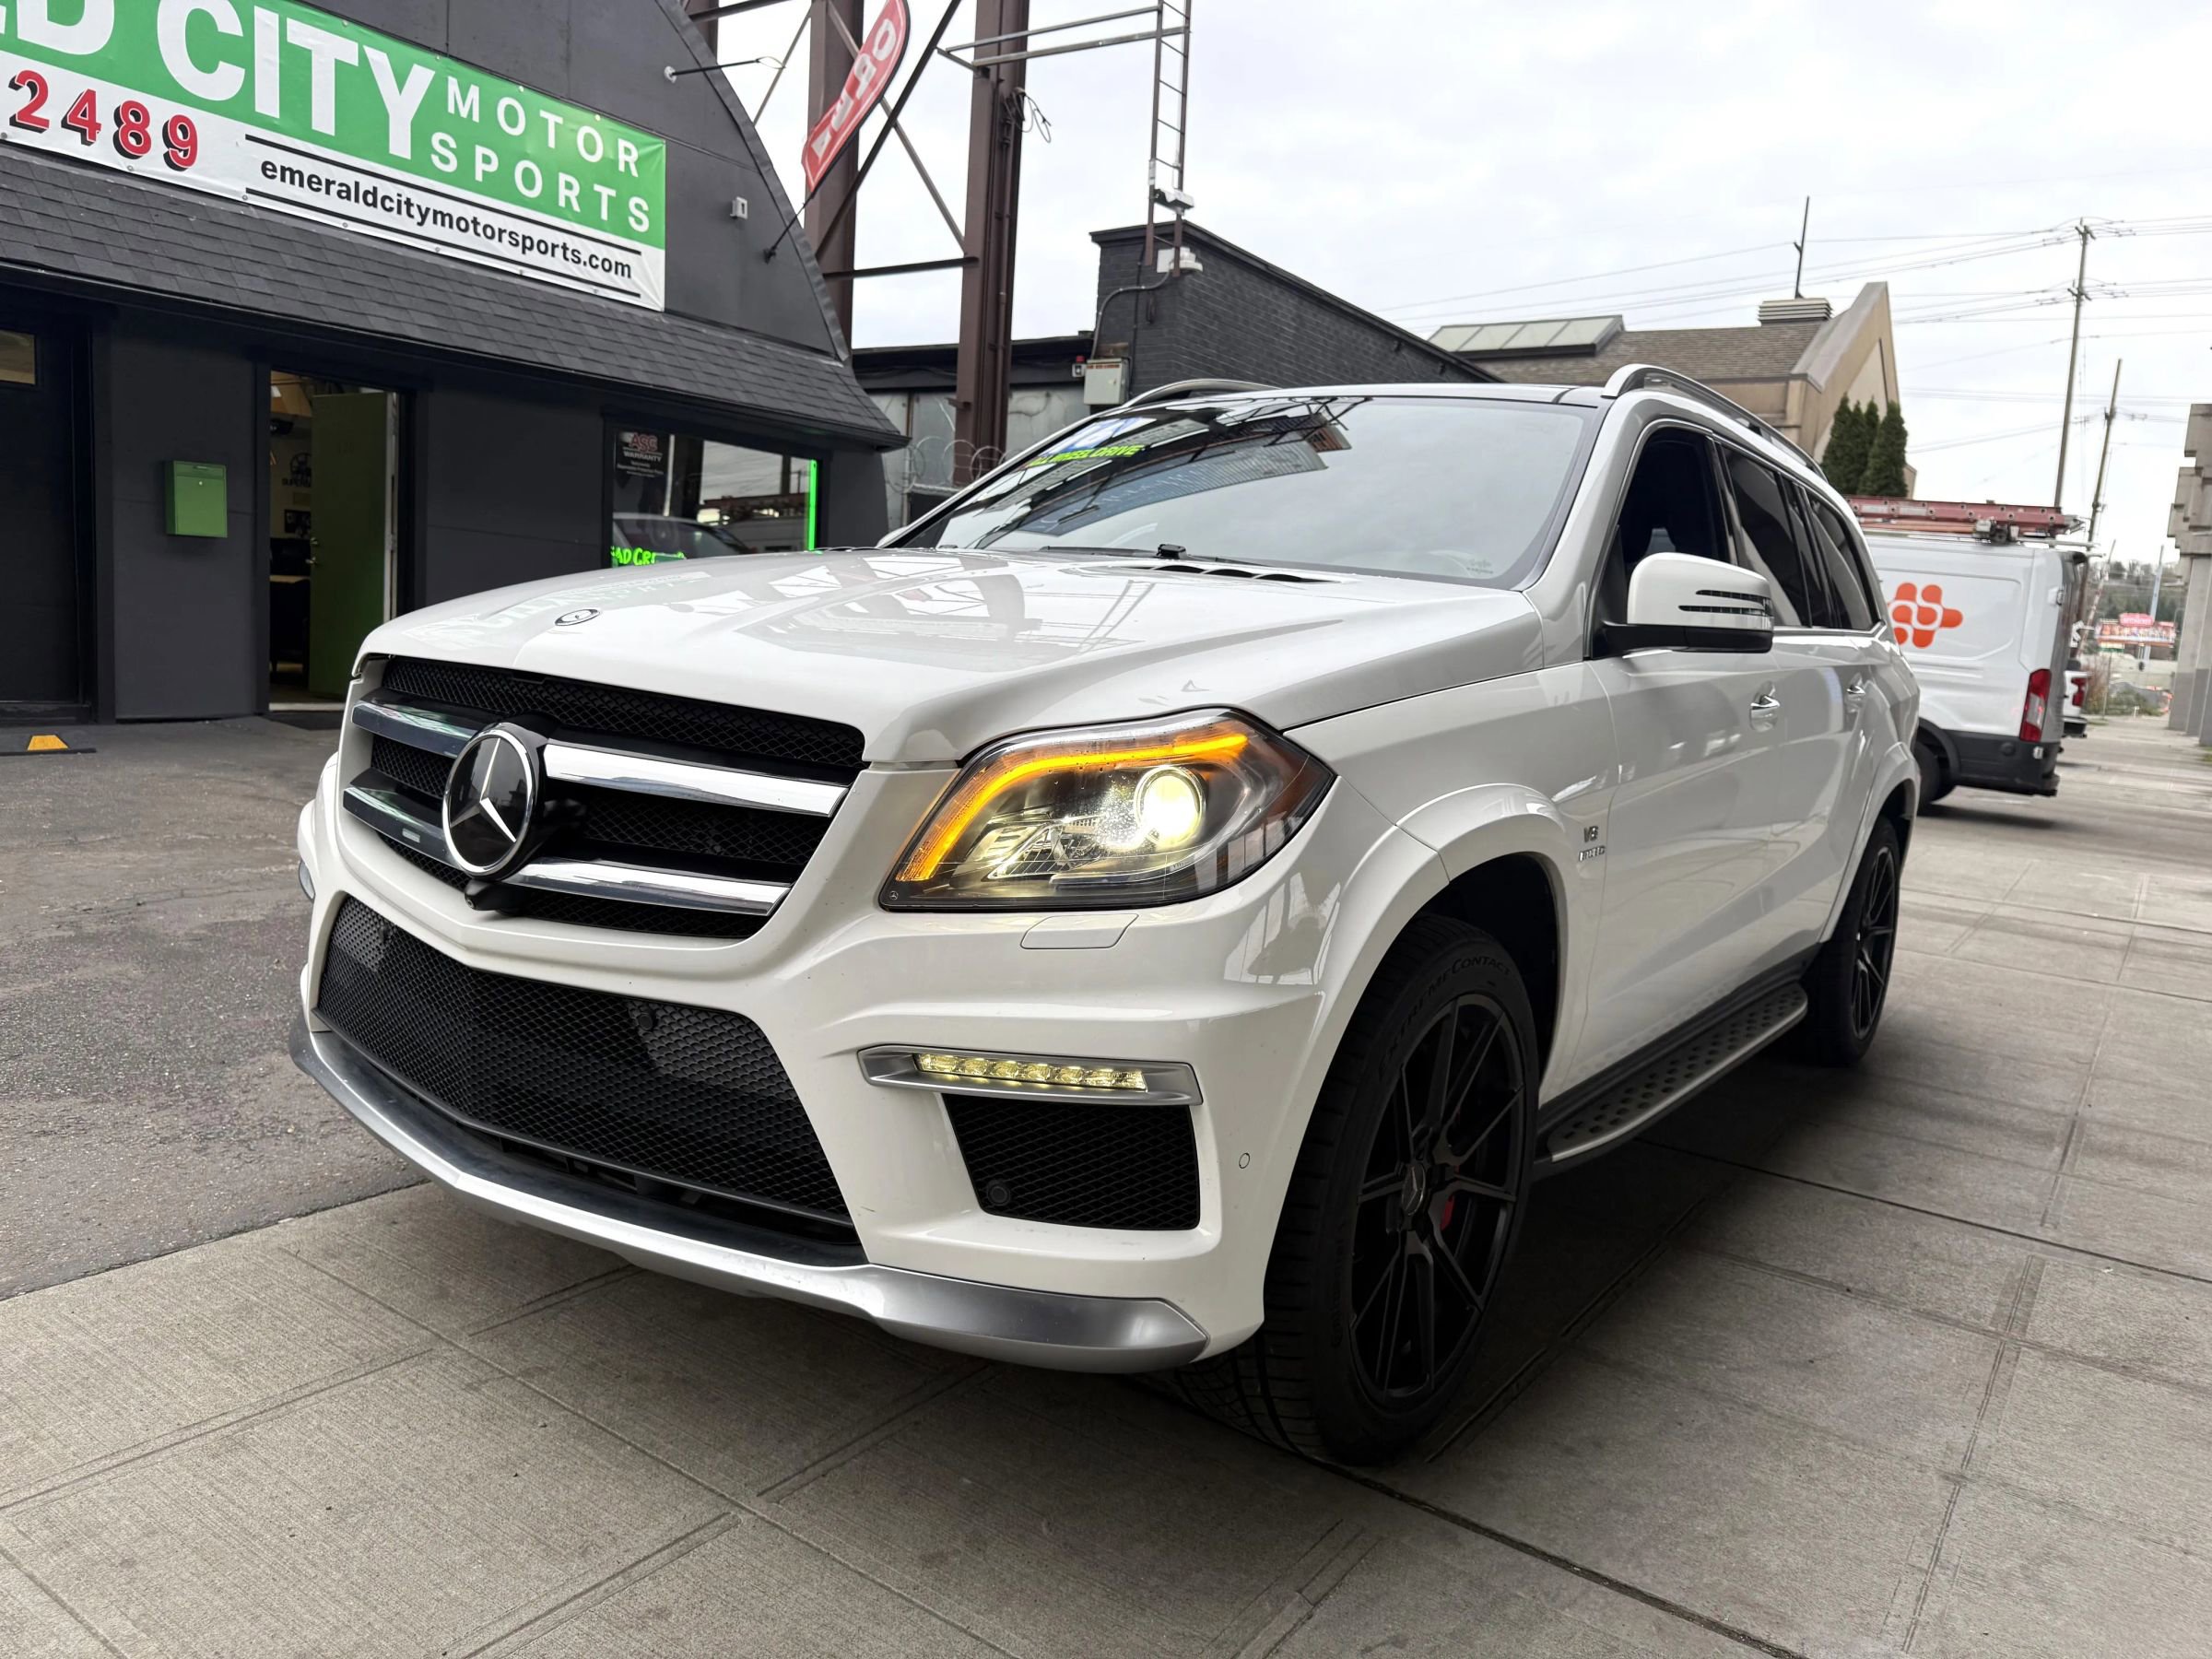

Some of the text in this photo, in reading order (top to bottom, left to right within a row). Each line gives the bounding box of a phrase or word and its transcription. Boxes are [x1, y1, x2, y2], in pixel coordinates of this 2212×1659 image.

[8, 69, 198, 171] 2489
[157, 0, 436, 160] CITY
[447, 76, 639, 177] MOTOR
[260, 159, 632, 278] emeraldcitymotorsports.com
[430, 132, 650, 232] SPORTS
[1089, 444, 1145, 457] DRIVE
